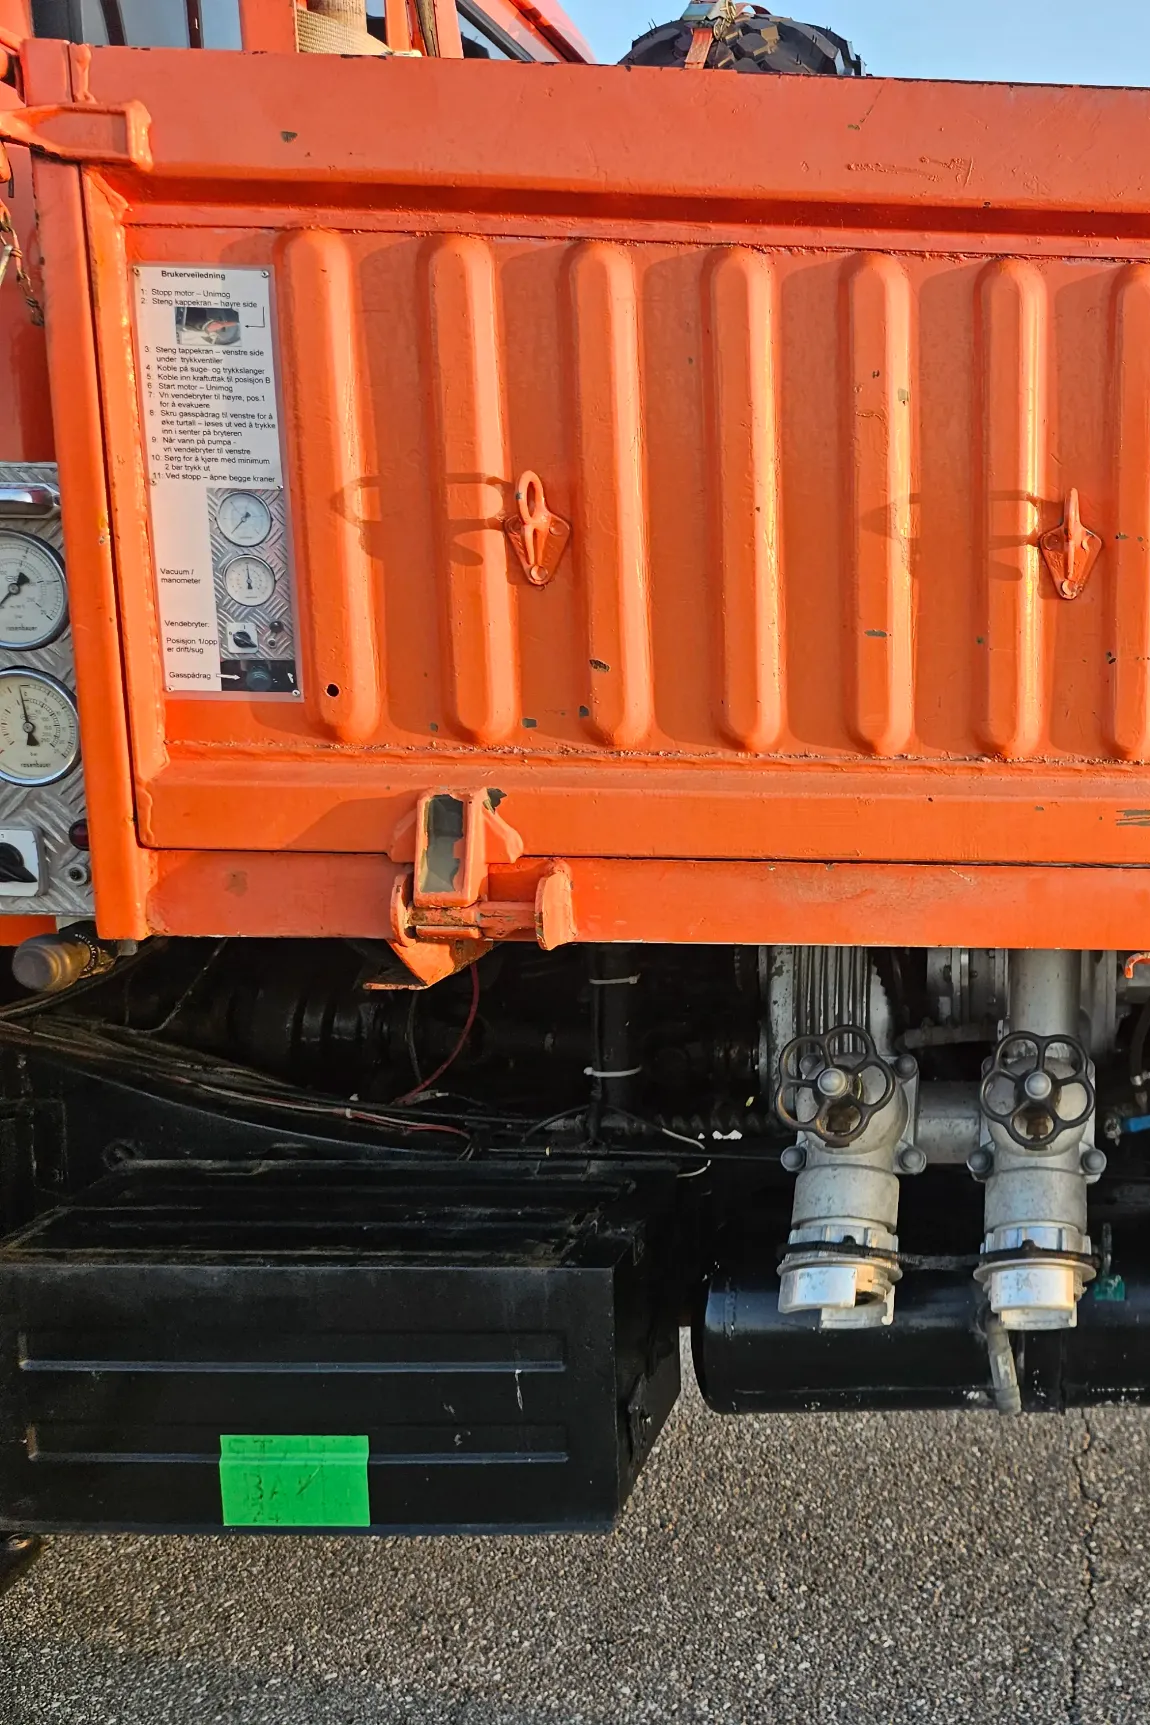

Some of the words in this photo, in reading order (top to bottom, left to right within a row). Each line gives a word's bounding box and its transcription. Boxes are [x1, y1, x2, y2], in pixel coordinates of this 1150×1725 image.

[162, 271, 226, 280] Brukerveiledning
[203, 290, 230, 298] Unimog
[152, 298, 172, 306] Steng
[206, 384, 233, 392] Unimog
[180, 410, 220, 419] gasspådrag
[164, 620, 210, 628] Vendebryter:
[167, 637, 195, 646] Posisjon
[169, 671, 211, 680] Gasspådrag
